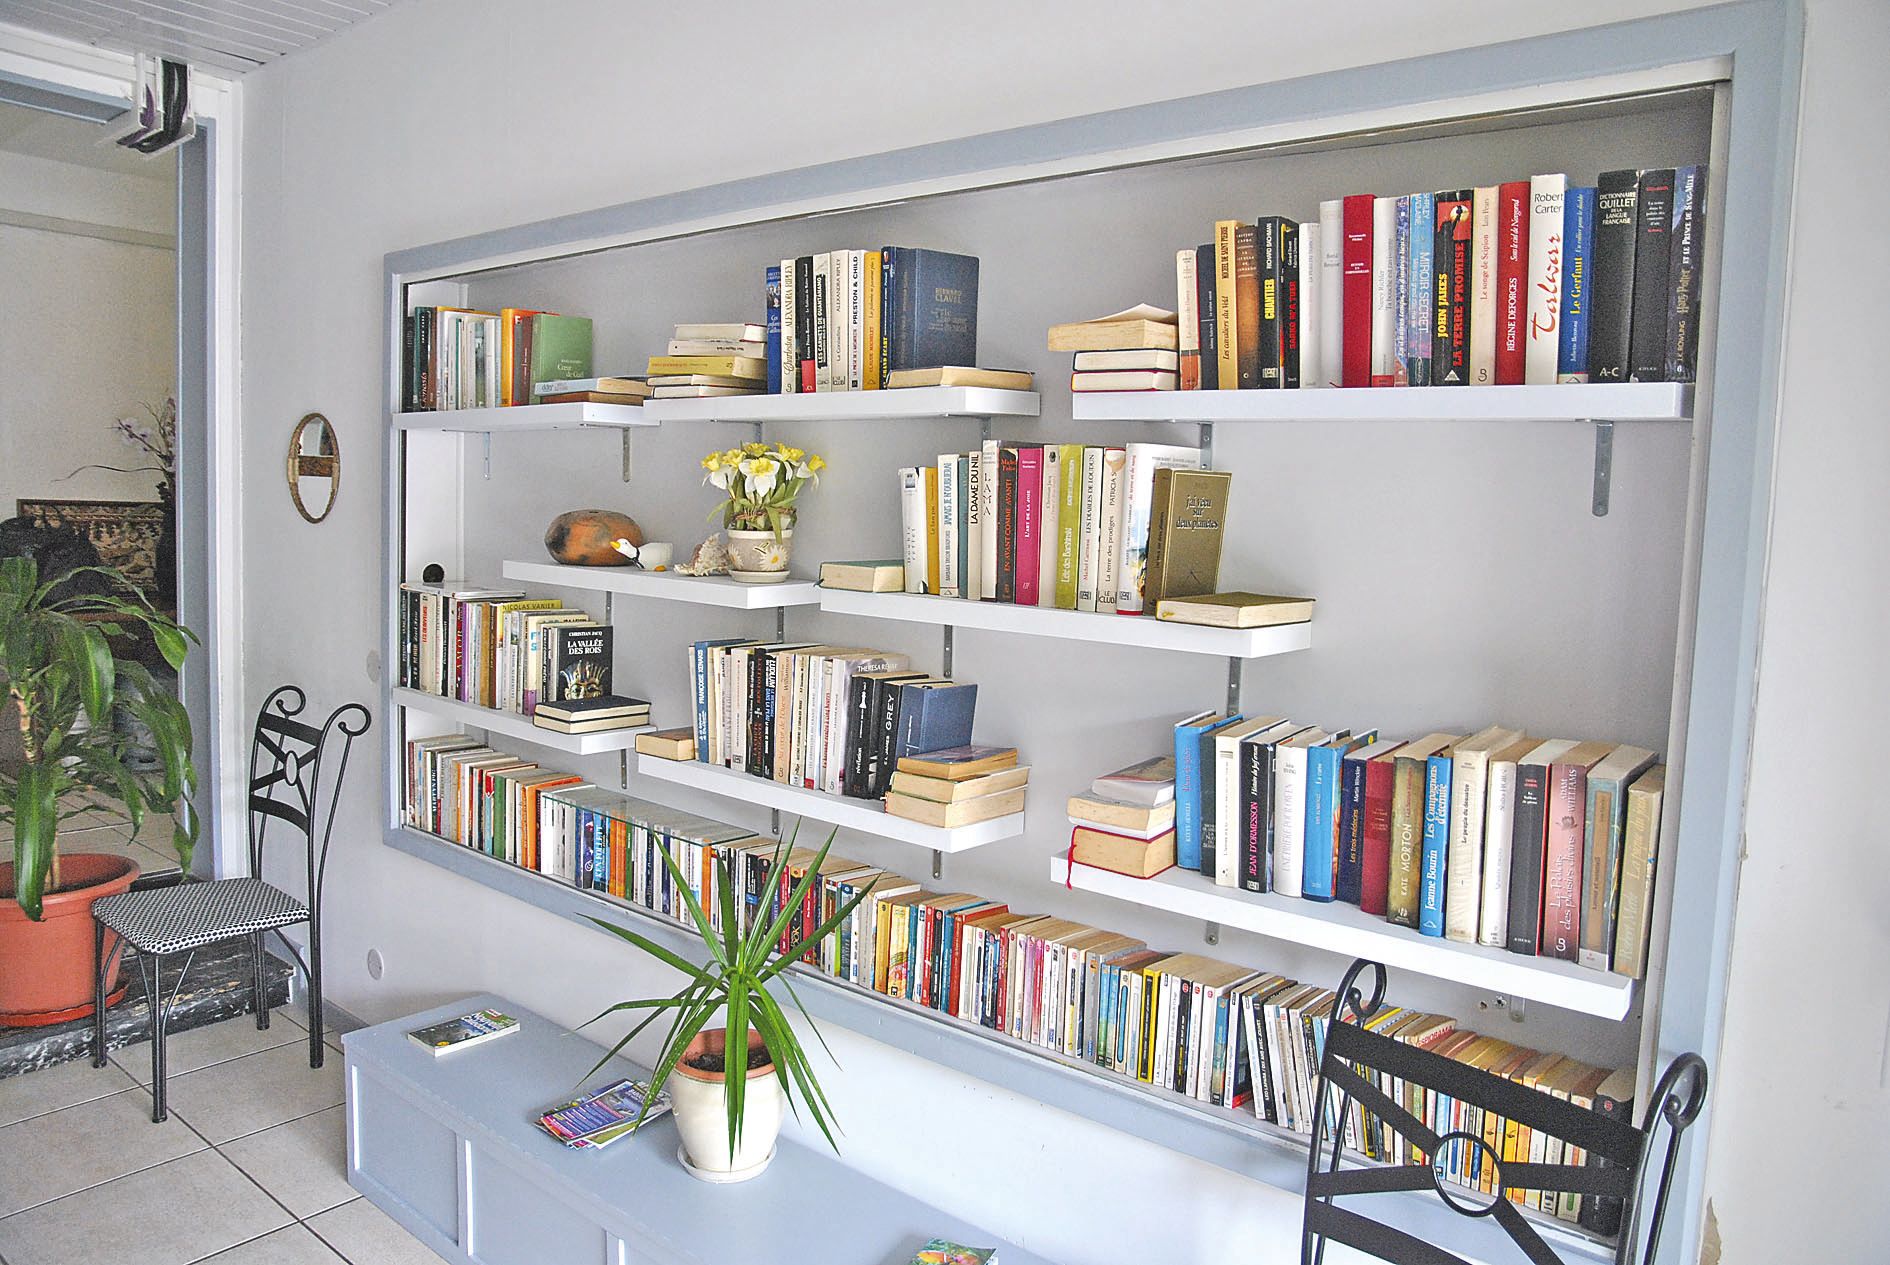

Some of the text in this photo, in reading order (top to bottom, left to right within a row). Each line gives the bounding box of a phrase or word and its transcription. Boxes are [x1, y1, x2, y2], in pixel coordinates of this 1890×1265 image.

[1534, 193, 1564, 202] Robert
[1535, 205, 1562, 214] Carter
[1600, 192, 1636, 200] DICTIONNAIRE
[1600, 198, 1636, 208] QUILLET
[1220, 226, 1229, 242] PIERRE
[1221, 242, 1229, 256] SAINT
[1479, 234, 1490, 300] Le songe de Scipion
[784, 264, 793, 328] ALEXANDRA RIPLEY
[1264, 278, 1275, 320] CHANTIER
[1418, 252, 1430, 334] MIROIR SECRET
[1569, 256, 1583, 315] Le Gerfaut
[1437, 273, 1449, 338] JOHN JAKES
[1452, 242, 1465, 367] LA TERRE PROMISE
[1505, 277, 1517, 352] RÉGINE DEFORGES
[817, 316, 823, 325] DE
[783, 335, 795, 376] Charleston
[1600, 367, 1619, 377] A-C
[1086, 454, 1095, 484] LOUDUN
[970, 454, 979, 525] LA DAME DU NIL
[1087, 484, 1094, 494] DE
[944, 505, 952, 527] JAMAIS
[1025, 503, 1031, 512] LA
[1025, 511, 1031, 521] DE
[1085, 494, 1093, 521] DIABLES
[1004, 508, 1012, 536] COMME
[1107, 515, 1115, 544] prodiges
[1175, 516, 1190, 529] deux
[1004, 535, 1012, 560] AVANT
[1004, 559, 1011, 571] EN
[1105, 574, 1111, 582] La
[567, 638, 604, 648] LA VALLÉE
[568, 646, 602, 655] DES ROIS
[768, 659, 776, 689] LUDLUM
[885, 693, 895, 731] GREY
[1425, 764, 1438, 839] Les Compagnons
[1560, 778, 1569, 801] ADAM
[1567, 768, 1577, 812] WILLIAMS
[1351, 808, 1359, 838] médecins
[1462, 808, 1469, 816] du
[594, 824, 604, 879] KEN FOLLETT
[1248, 801, 1258, 876] JEAN D'ORMESSON
[1400, 822, 1412, 872] MORTON
[1401, 877, 1409, 897] KATE
[1425, 849, 1437, 911] Jeanne Bourin
[1549, 854, 1564, 909] Le Palais
[1559, 834, 1576, 931] des plaisirs divins
